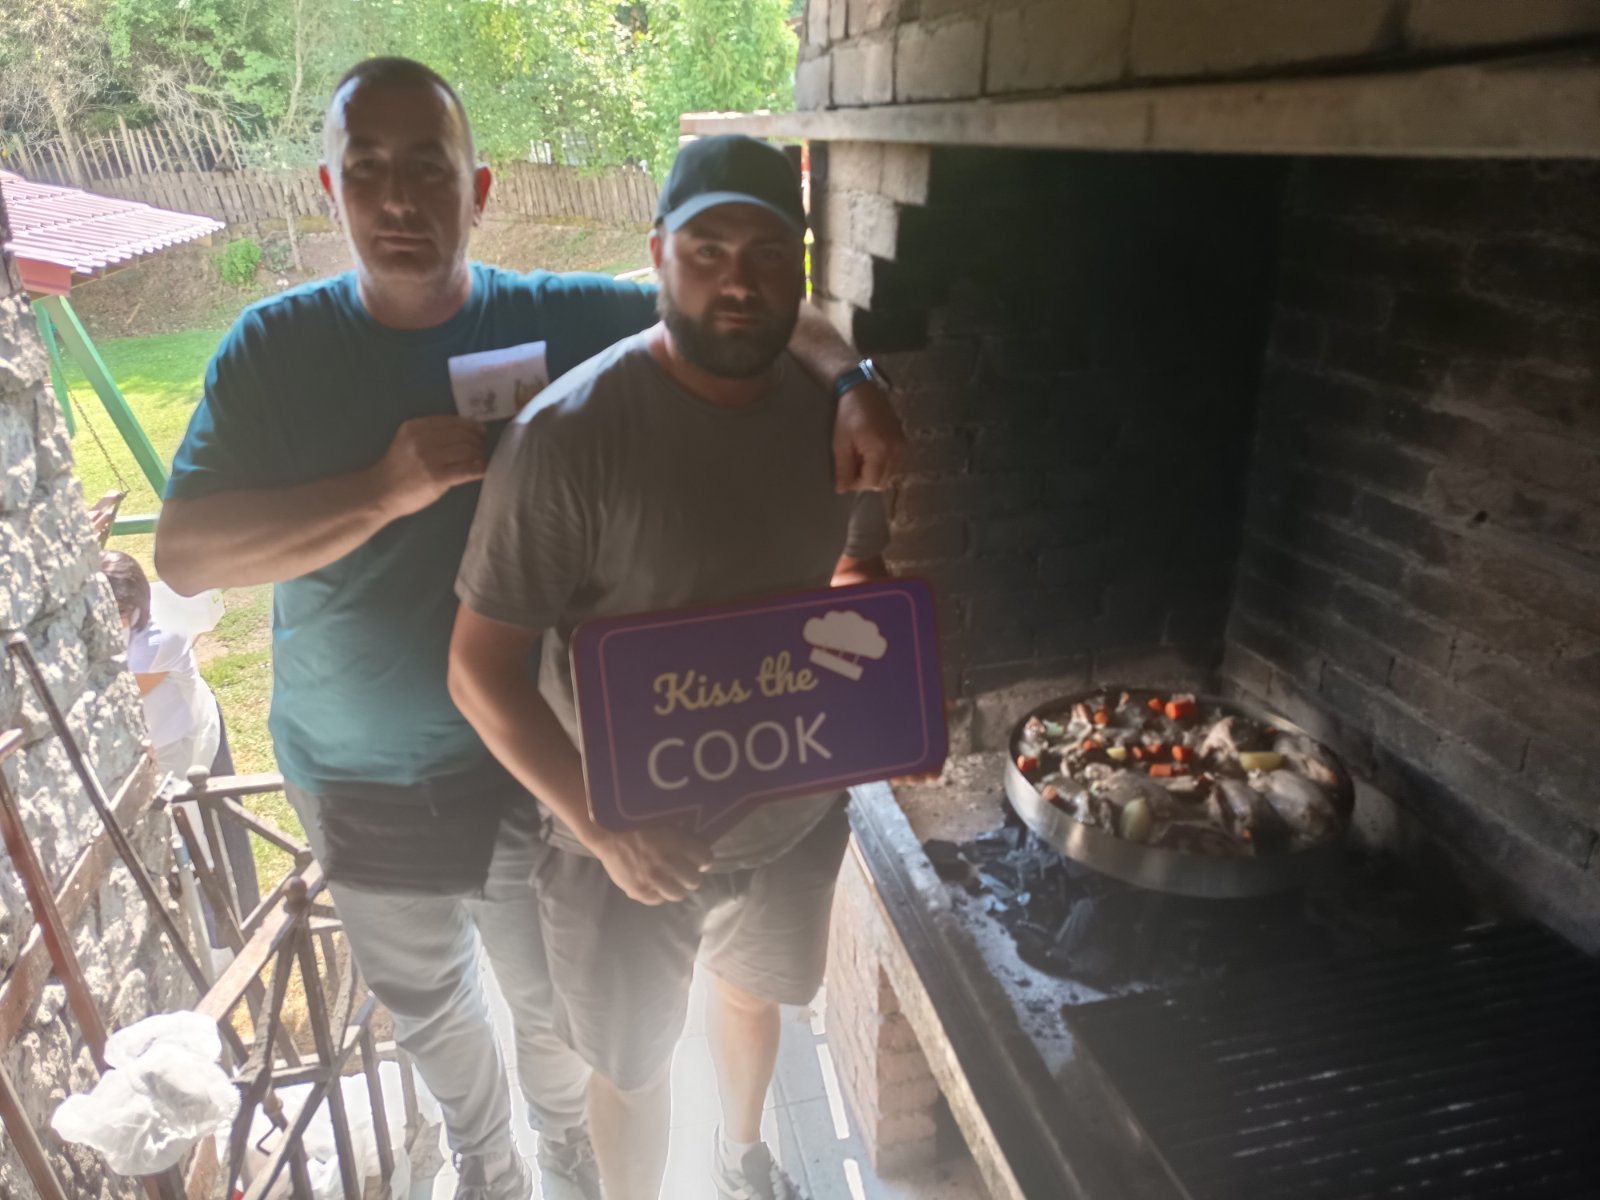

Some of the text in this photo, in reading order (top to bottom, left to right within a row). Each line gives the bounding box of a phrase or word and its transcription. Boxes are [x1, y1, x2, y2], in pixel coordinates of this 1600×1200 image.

[653, 650, 819, 716] Kiss the
[647, 712, 832, 790] COOK
